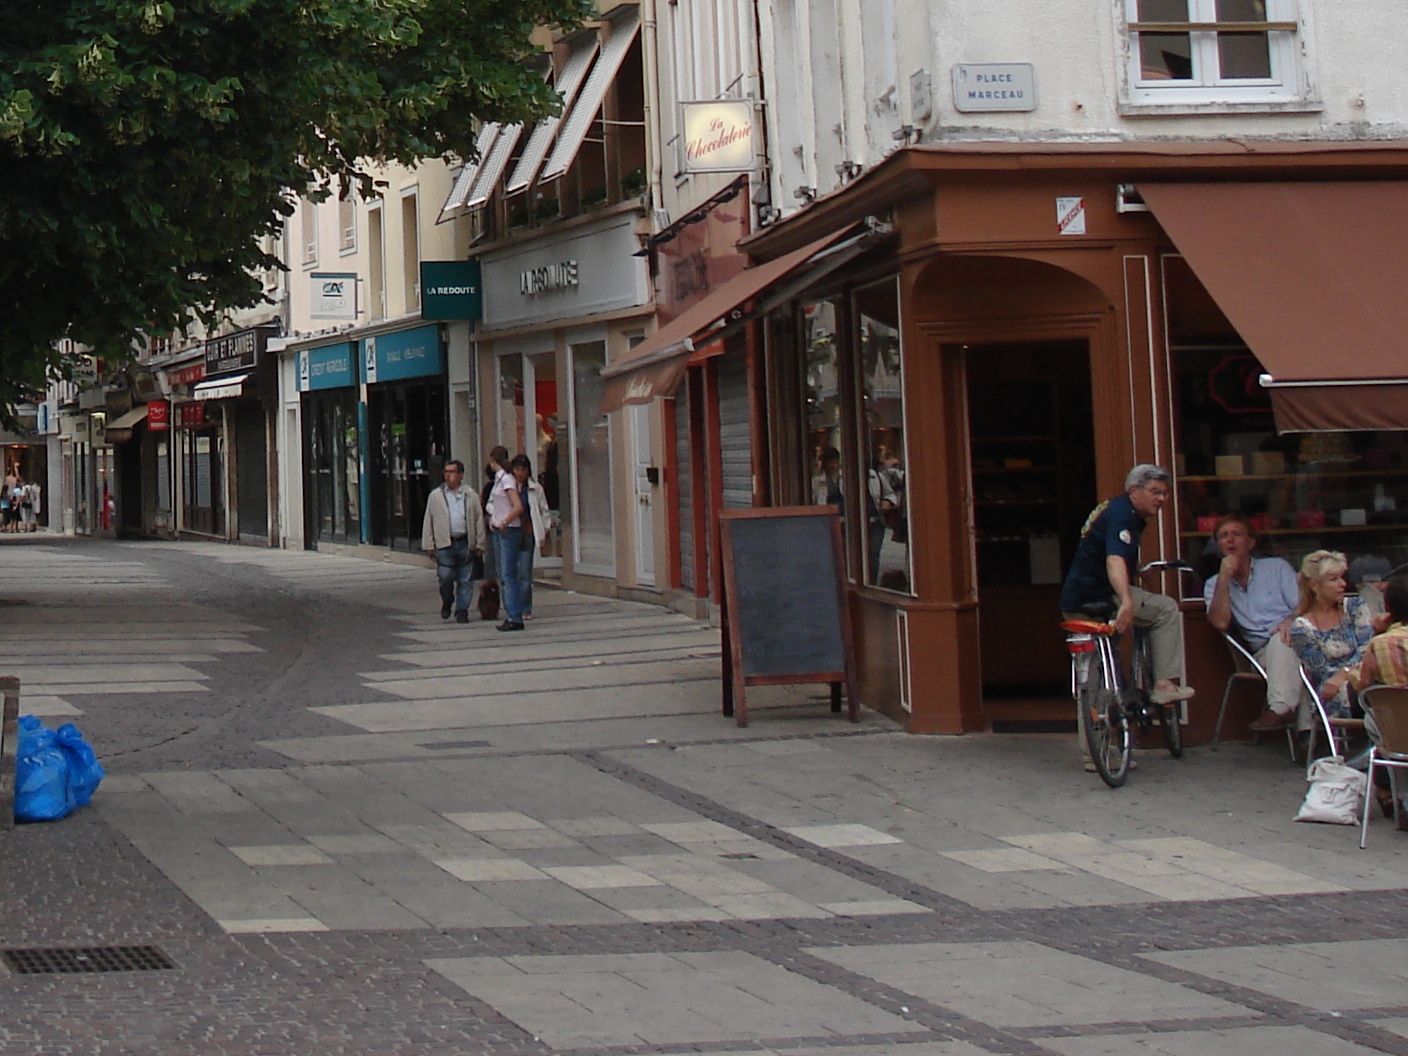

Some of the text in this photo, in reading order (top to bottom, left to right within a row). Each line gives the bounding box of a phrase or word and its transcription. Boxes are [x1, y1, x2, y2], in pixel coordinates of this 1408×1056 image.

[976, 74, 1012, 83] PLACE
[968, 90, 1024, 99] MARCEAU
[709, 118, 724, 132] La
[686, 121, 752, 161] Chocolaterie
[427, 286, 476, 295] LA REDOUTE
